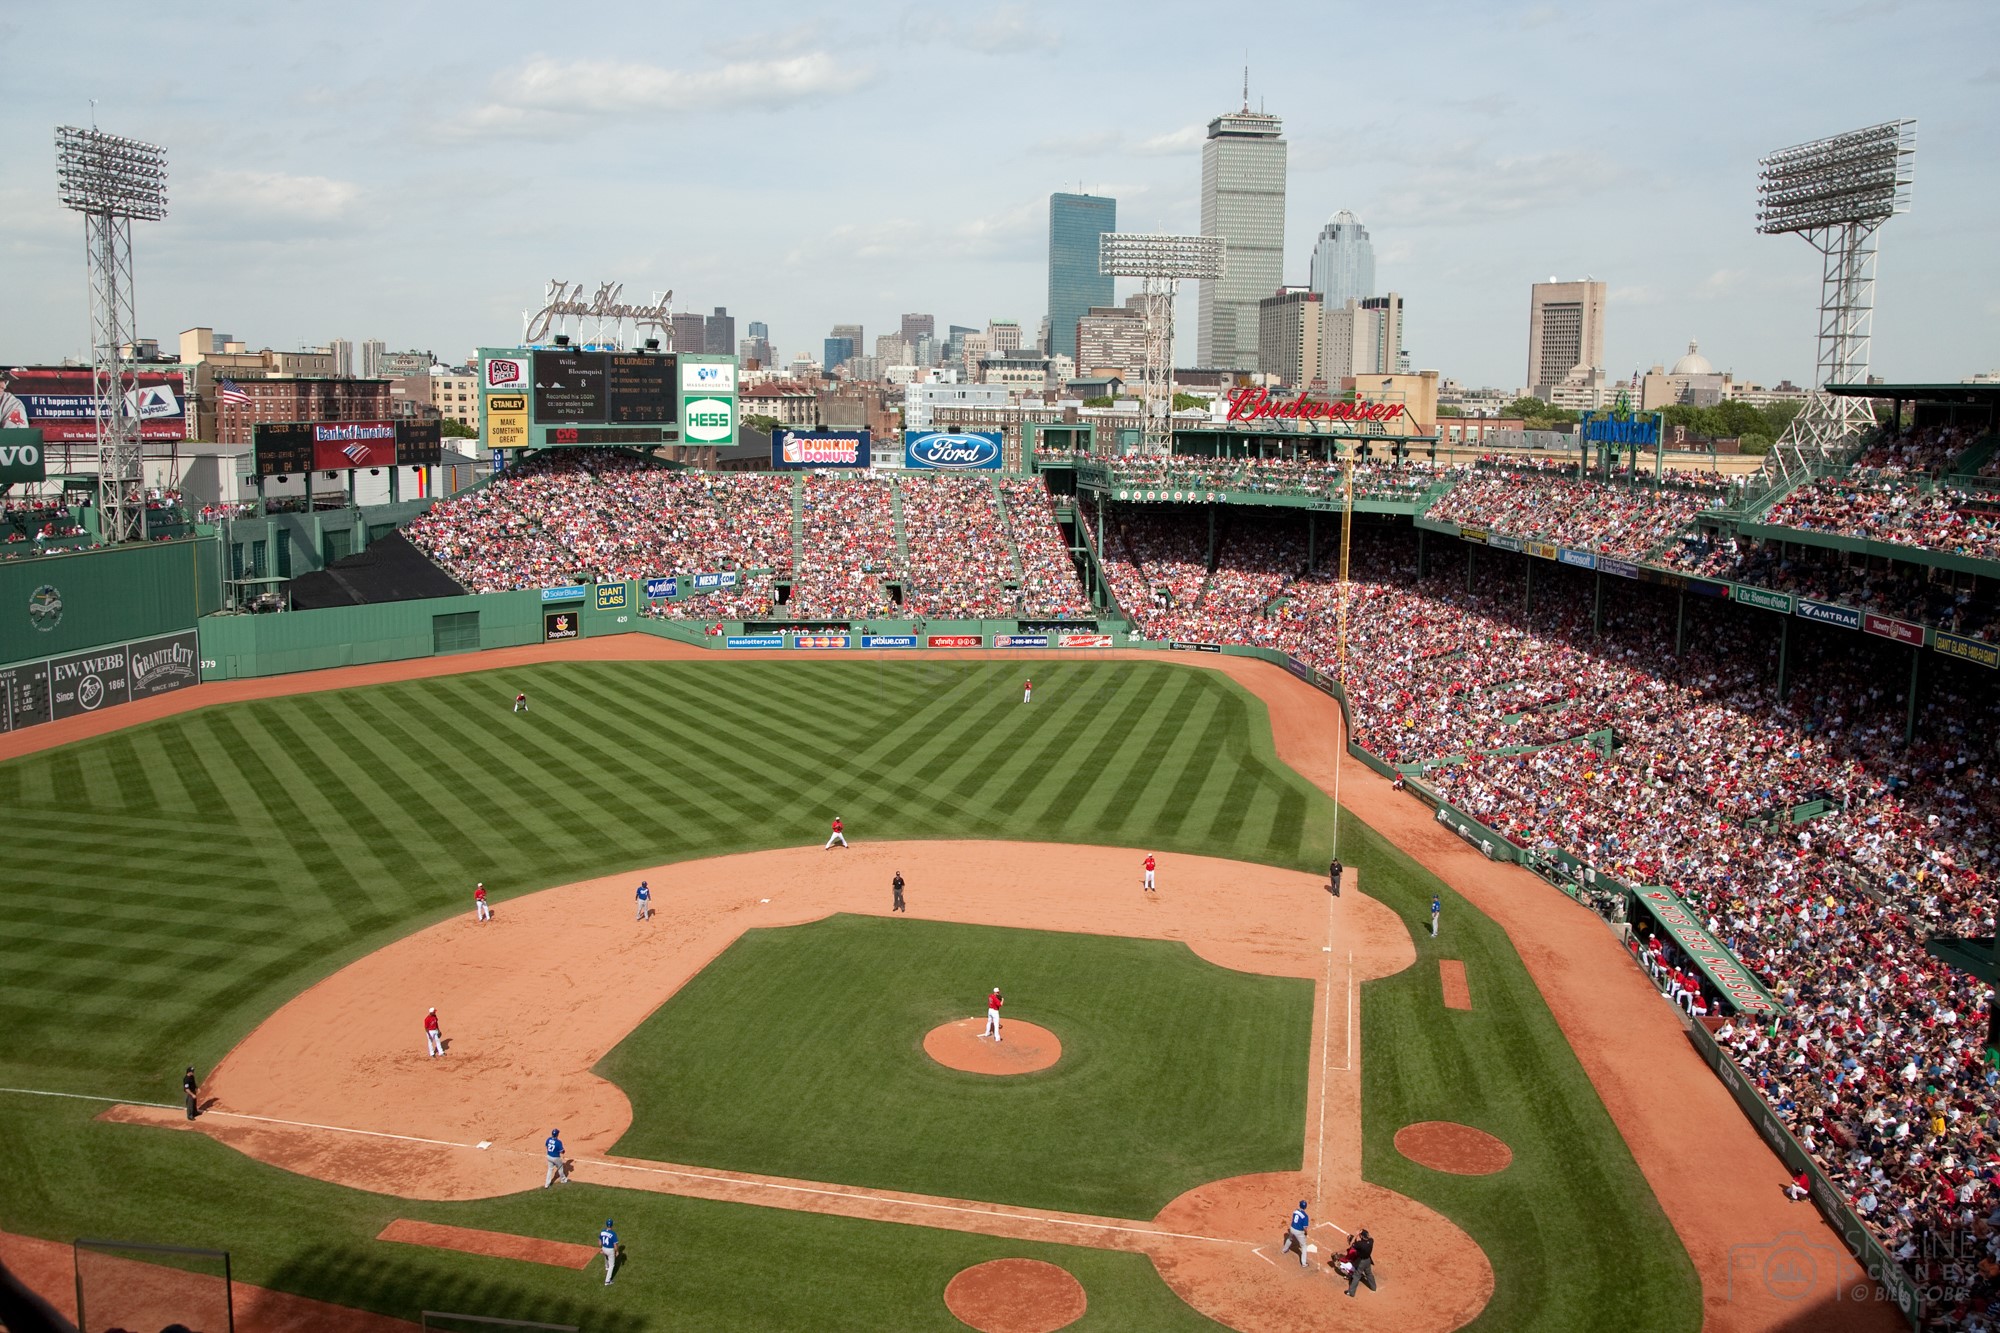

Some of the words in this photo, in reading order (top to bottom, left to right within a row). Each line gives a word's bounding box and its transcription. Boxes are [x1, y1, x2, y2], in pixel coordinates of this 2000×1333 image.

[526, 279, 588, 343] John
[588, 281, 677, 336] Hancock
[494, 362, 515, 373] ACE
[581, 379, 586, 388] 8
[31, 397, 38, 405] If
[39, 397, 45, 405] it
[47, 397, 79, 408] happens
[80, 397, 87, 405] in
[493, 401, 522, 409] STANLEY
[1227, 387, 1405, 422] Budweiser
[36, 408, 42, 416] it
[44, 408, 75, 419] happens
[76, 408, 84, 416] in
[688, 413, 728, 427] HESS
[268, 425, 289, 433] LESTER
[317, 426, 343, 441] Bank
[344, 424, 354, 440] of
[355, 424, 394, 440] America
[492, 427, 524, 435] SOMETHING
[556, 428, 578, 438] CVS
[803, 439, 859, 451] DUNKIN'
[927, 438, 979, 462] Ford
[1595, 443, 1642, 453] FARMS
[0, 445, 39, 466] VO
[803, 451, 859, 463] DONUTS
[1564, 551, 1591, 566] Microsoft
[699, 575, 719, 586] NESN
[599, 587, 623, 597] GIANT
[598, 596, 624, 605] GLASS
[1740, 590, 1750, 600] The
[1751, 591, 1771, 607] Boston
[1771, 595, 1787, 610] Globe
[1813, 609, 1857, 626] AMTRAK
[1873, 620, 1889, 634] Ninety
[1899, 626, 1912, 638] Nine
[729, 638, 782, 646] masslottery.com
[870, 636, 910, 646] jetblue.com
[1064, 635, 1103, 647] Budweiser
[1128, 634, 1140, 642] 380
[1937, 637, 1952, 650] GIANT
[1951, 640, 1968, 656] GLASS
[132, 649, 172, 679] GRANITE
[173, 642, 194, 667] CITY
[200, 660, 216, 669] 379
[54, 662, 81, 682] F.W.
[82, 653, 124, 676] WEBB
[155, 664, 175, 674] SUPPLY
[108, 679, 125, 691] 1866
[152, 683, 167, 692] SINCE
[168, 681, 180, 689] 1923
[56, 692, 74, 703] Since
[1652, 902, 1694, 928] SOX
[1675, 926, 1717, 953] RED
[1701, 955, 1774, 1012] BOSTON
[547, 1143, 556, 1152] 27
[1294, 1214, 1299, 1224] 8
[602, 1236, 609, 1246] 14
